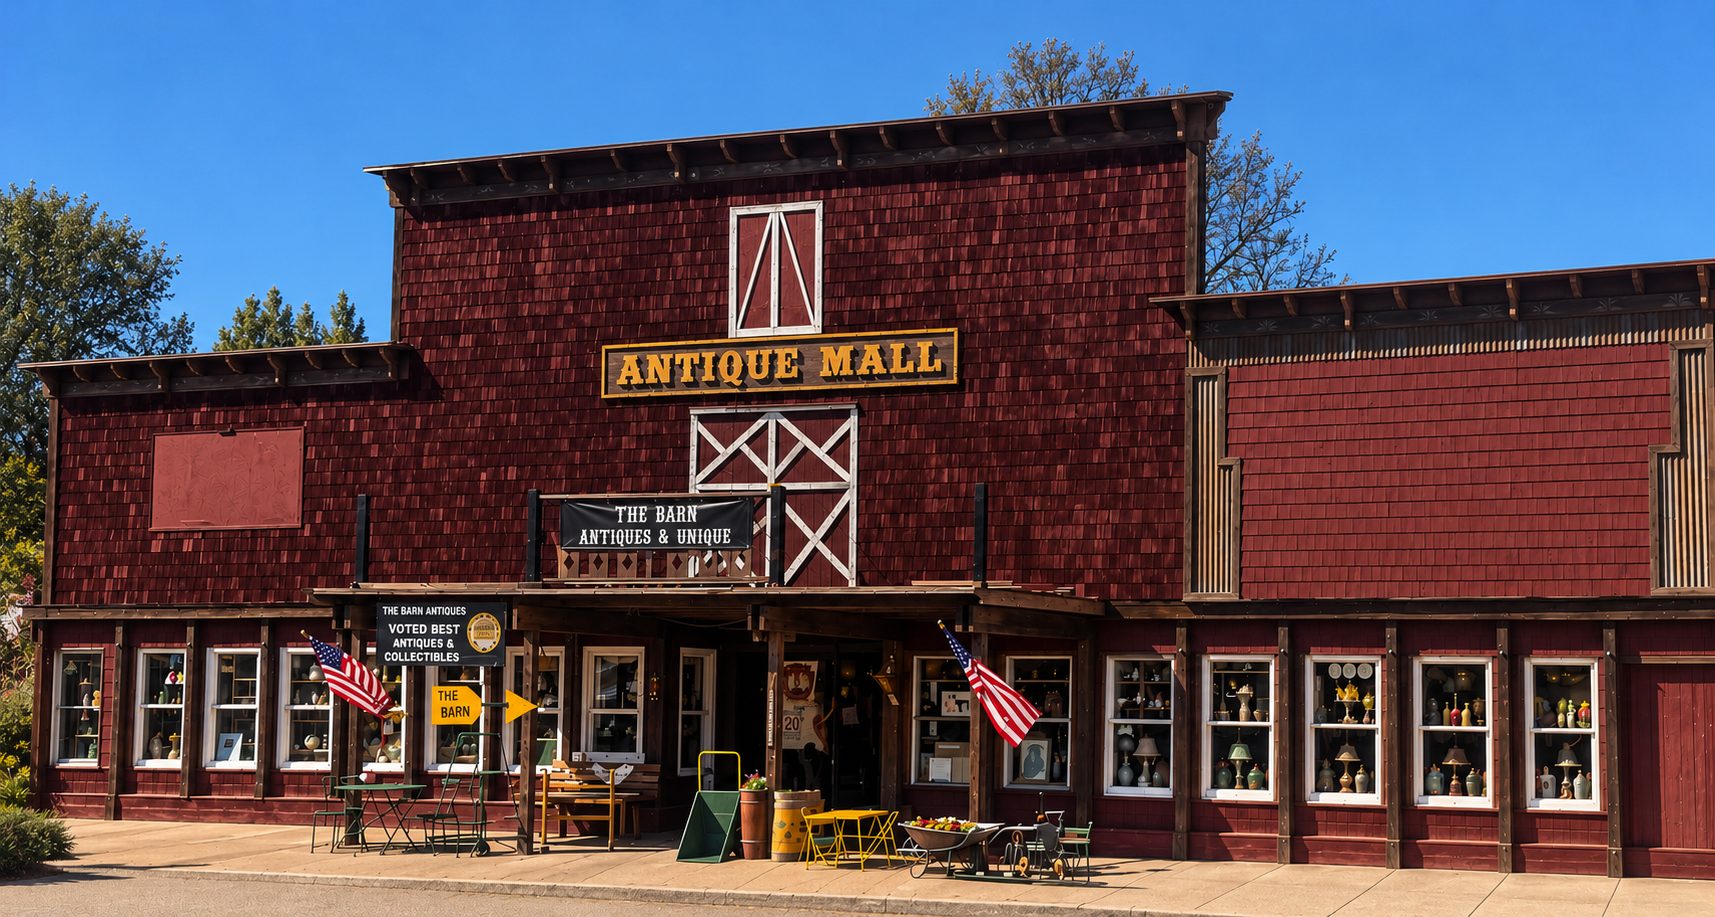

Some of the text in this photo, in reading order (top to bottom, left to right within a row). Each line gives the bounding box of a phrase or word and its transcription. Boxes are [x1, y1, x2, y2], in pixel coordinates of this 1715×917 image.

[616, 341, 942, 386] ANTIQUE MALL
[615, 505, 698, 523] THE BARN
[579, 528, 731, 547] ANTIQUES & UNIQUE
[382, 606, 467, 616] THE BARN ANTIQUES
[388, 623, 428, 635] VOTED
[431, 623, 461, 635] BEST
[392, 638, 455, 650] ANTIQUES &
[384, 651, 460, 662] COLLECTIBLES
[438, 690, 458, 701] THE
[441, 706, 470, 718] BARN
